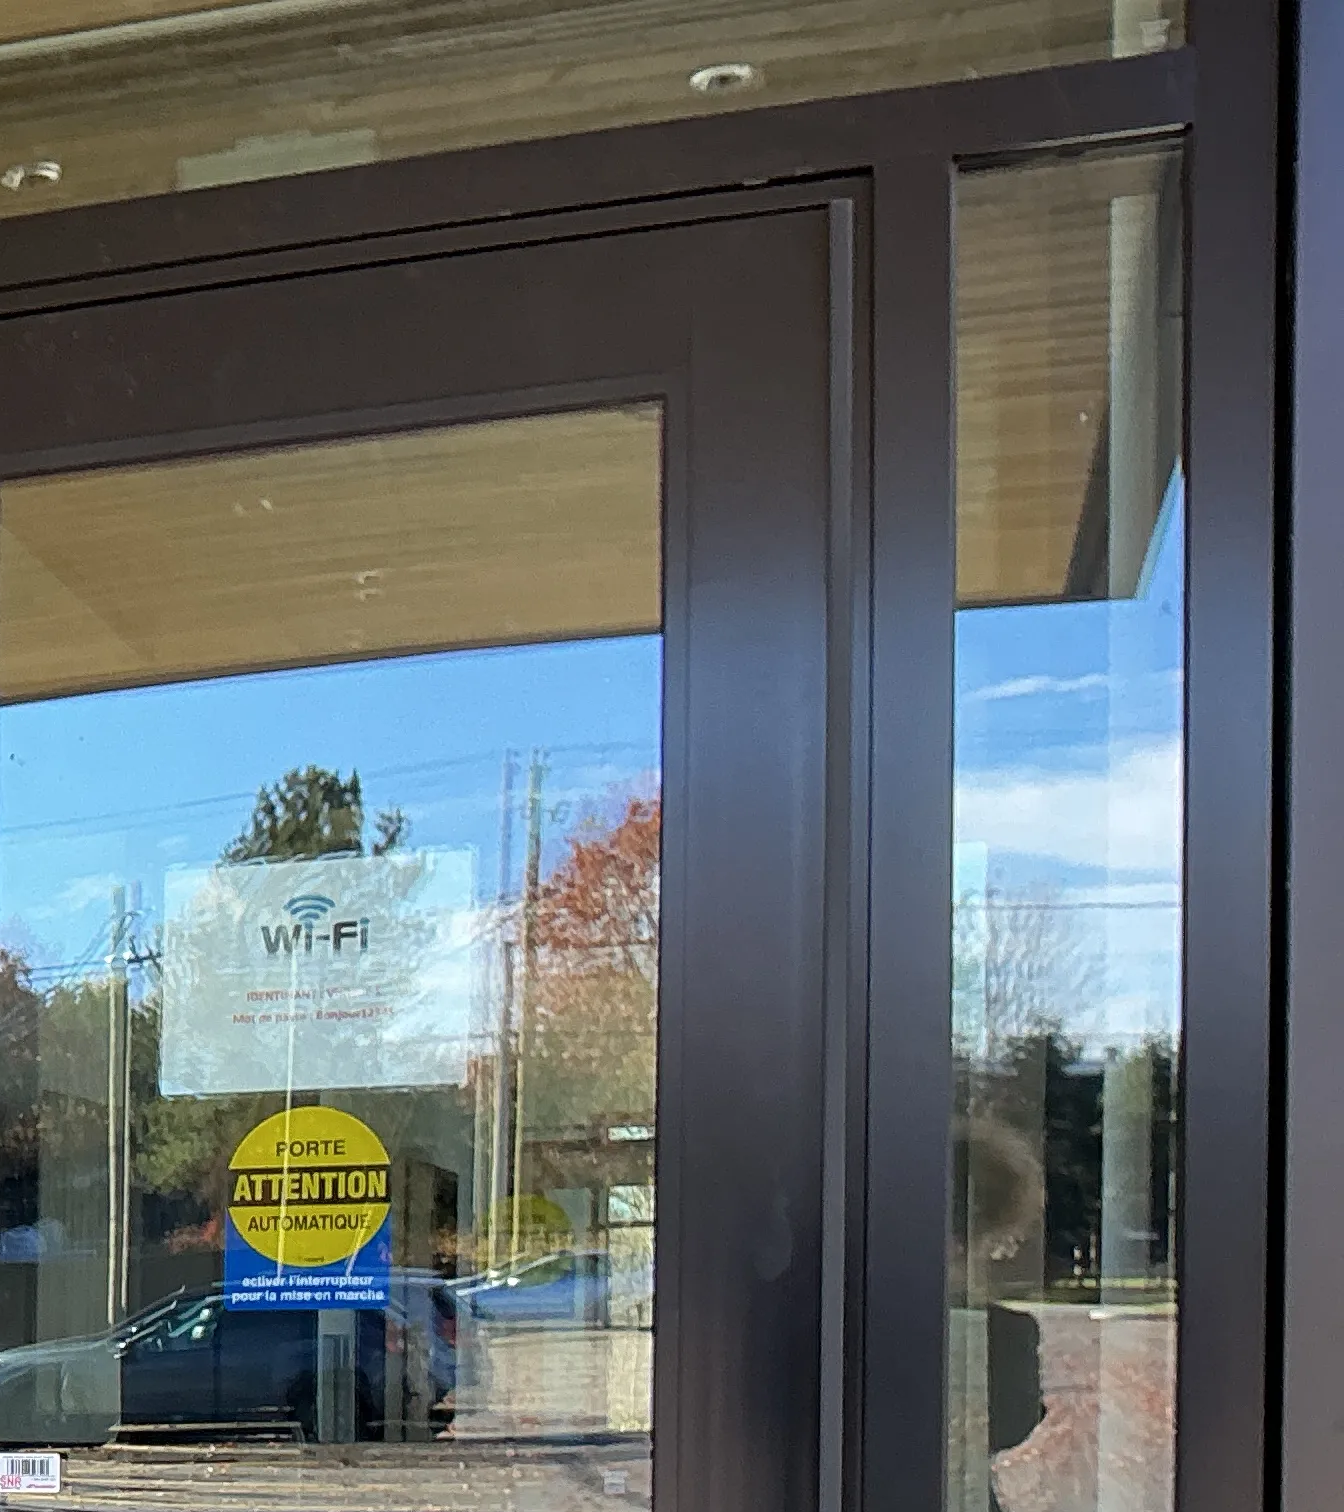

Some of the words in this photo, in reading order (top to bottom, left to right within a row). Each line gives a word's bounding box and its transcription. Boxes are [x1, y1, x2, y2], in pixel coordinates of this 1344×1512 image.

[261, 918, 370, 954] Wi-Fi
[276, 1139, 346, 1157] PORTE
[233, 1170, 387, 1201] ATTENTION
[247, 1213, 371, 1232] AUTOMATIQUE
[289, 1274, 374, 1288] l'interrupteur
[231, 1292, 264, 1304] pour
[265, 1289, 277, 1301] la
[280, 1290, 311, 1301] mise
[313, 1291, 331, 1301] en
[334, 1288, 385, 1301] marche
